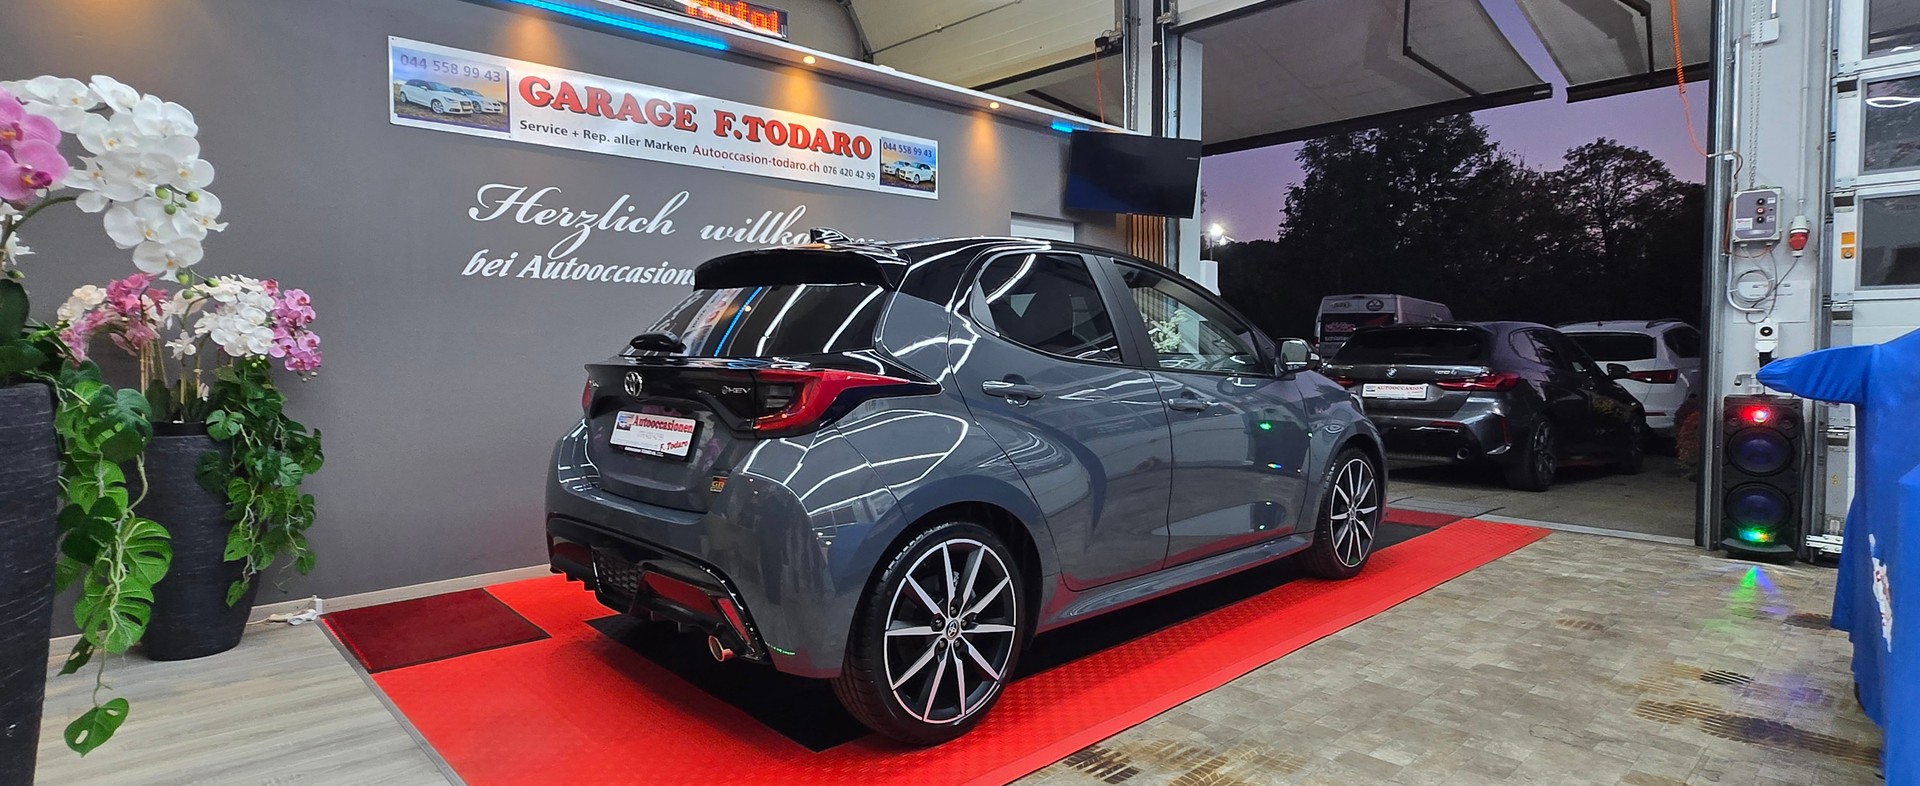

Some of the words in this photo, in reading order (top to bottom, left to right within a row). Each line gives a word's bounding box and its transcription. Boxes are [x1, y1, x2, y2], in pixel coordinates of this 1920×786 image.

[400, 54, 428, 70] 044
[433, 60, 459, 75] 558
[463, 65, 480, 78] 99
[484, 70, 501, 82] 43
[518, 75, 698, 133] GARAGE
[713, 109, 873, 160] F.TODARO
[519, 120, 568, 136] Service
[583, 129, 610, 143] Rep.
[614, 134, 641, 147] aller
[644, 138, 687, 153] Marken
[693, 144, 820, 173] Autooccasion-todaro.ch
[822, 165, 838, 175] 076
[839, 168, 854, 178] 420
[855, 170, 865, 179] 42
[866, 172, 876, 181] 99
[883, 141, 897, 151] 044
[898, 144, 912, 155] 558
[913, 147, 922, 156] 99
[923, 149, 933, 158] 43
[468, 183, 690, 260] Herzlich
[461, 249, 518, 278] bei
[633, 415, 693, 433] Autooccasionen
[666, 440, 689, 450] Todaro
